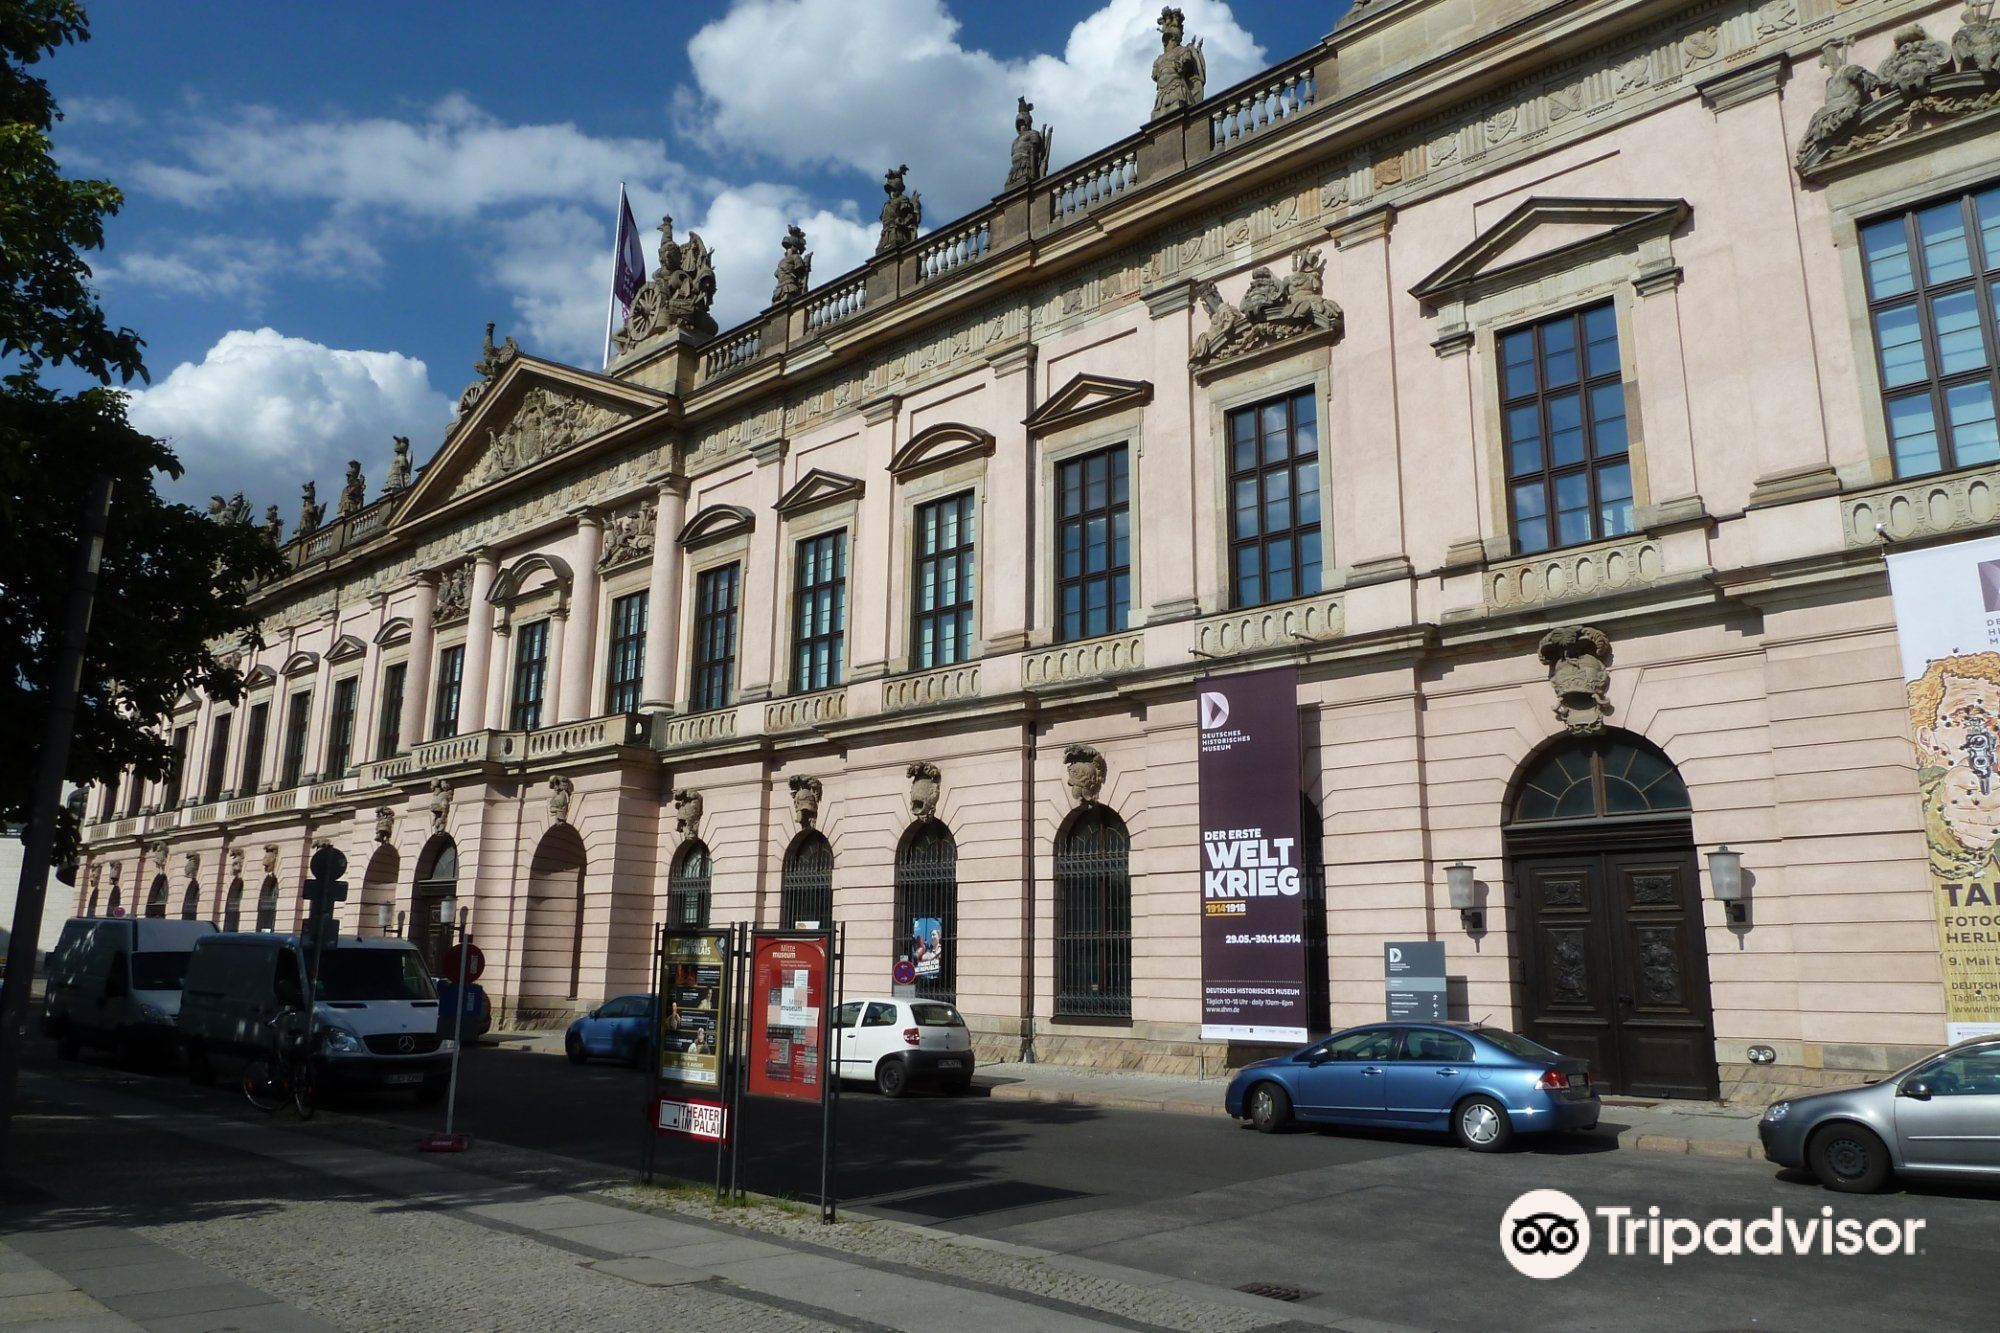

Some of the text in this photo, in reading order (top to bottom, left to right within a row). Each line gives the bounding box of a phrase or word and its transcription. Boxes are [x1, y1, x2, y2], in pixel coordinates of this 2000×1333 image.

[1202, 730, 1241, 739] DEUTSCHES
[1202, 735, 1251, 746] HISTORISCHES
[1203, 744, 1232, 752] MUSEUM
[1204, 828, 1262, 841] DER ERSTE
[1205, 838, 1294, 869] WELT
[1205, 867, 1300, 898] KRIEG
[1949, 957, 1961, 966] 9.
[1966, 956, 1990, 966] Mai
[1236, 987, 1274, 995] HISTORISCHES
[1275, 988, 1300, 996] MUSEUM
[681, 1105, 720, 1121] THEATER
[681, 1118, 720, 1135] IM PALAI
